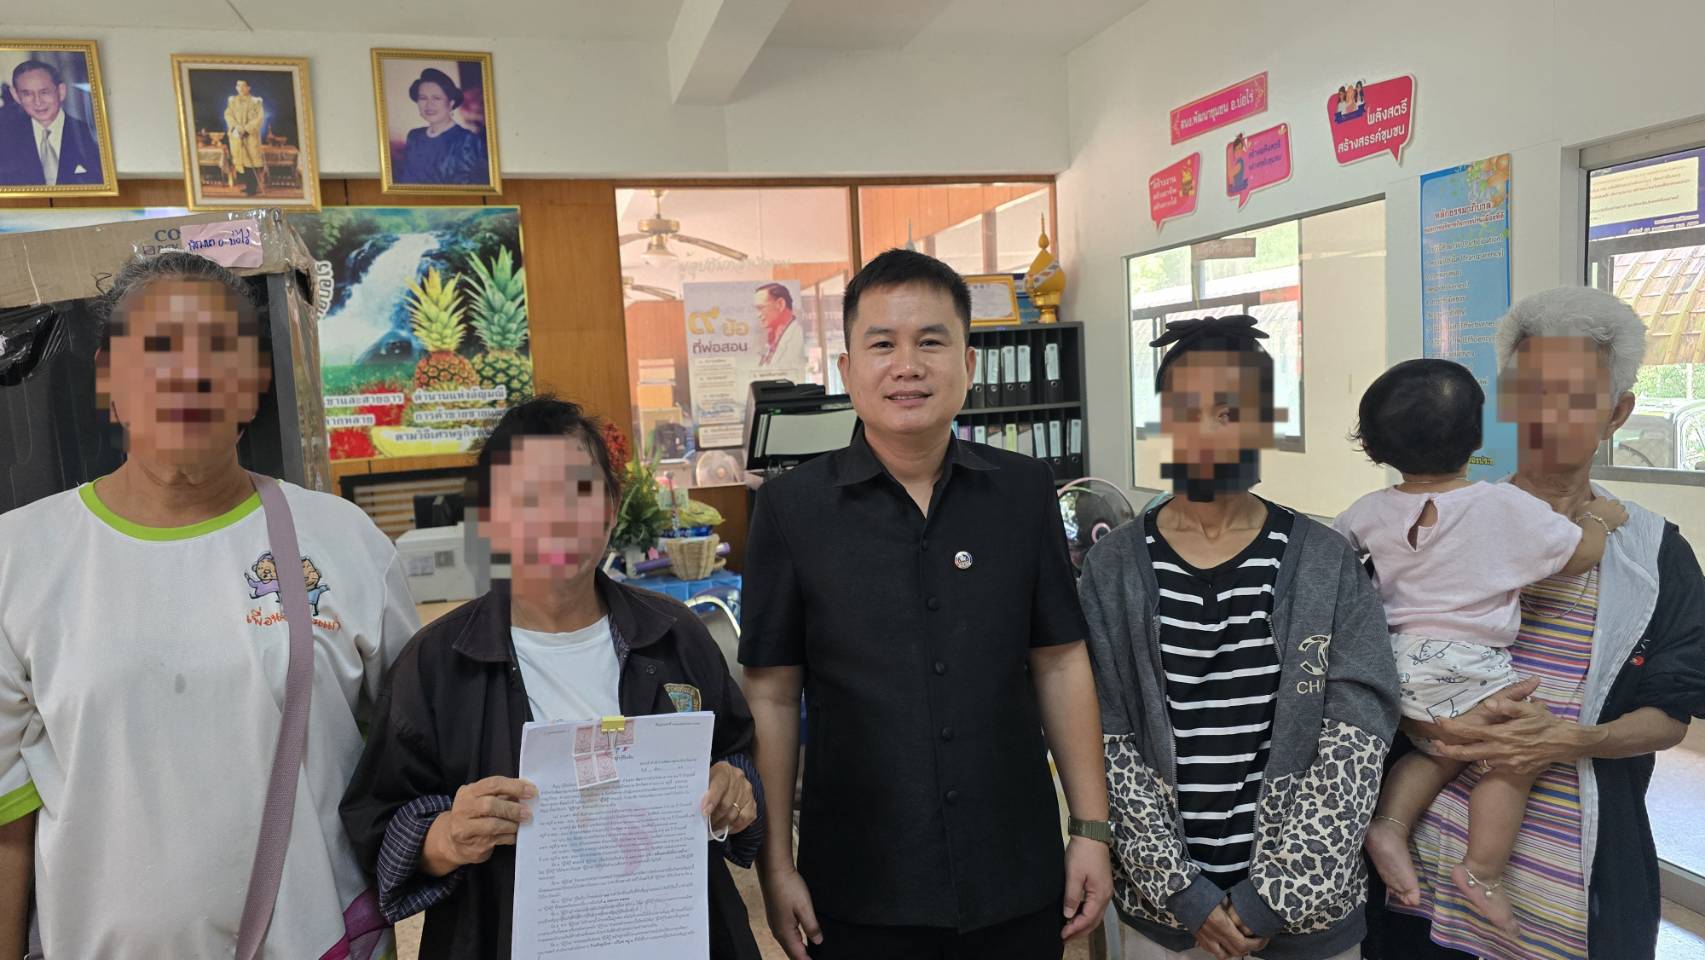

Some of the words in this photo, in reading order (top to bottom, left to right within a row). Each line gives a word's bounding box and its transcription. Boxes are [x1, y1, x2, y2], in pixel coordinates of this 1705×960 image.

[1367, 97, 1408, 126] พลังสตรี
[1337, 124, 1405, 153] สร้างสรรค์ชุมชน
[692, 339, 748, 355] ที่พ่อสอน
